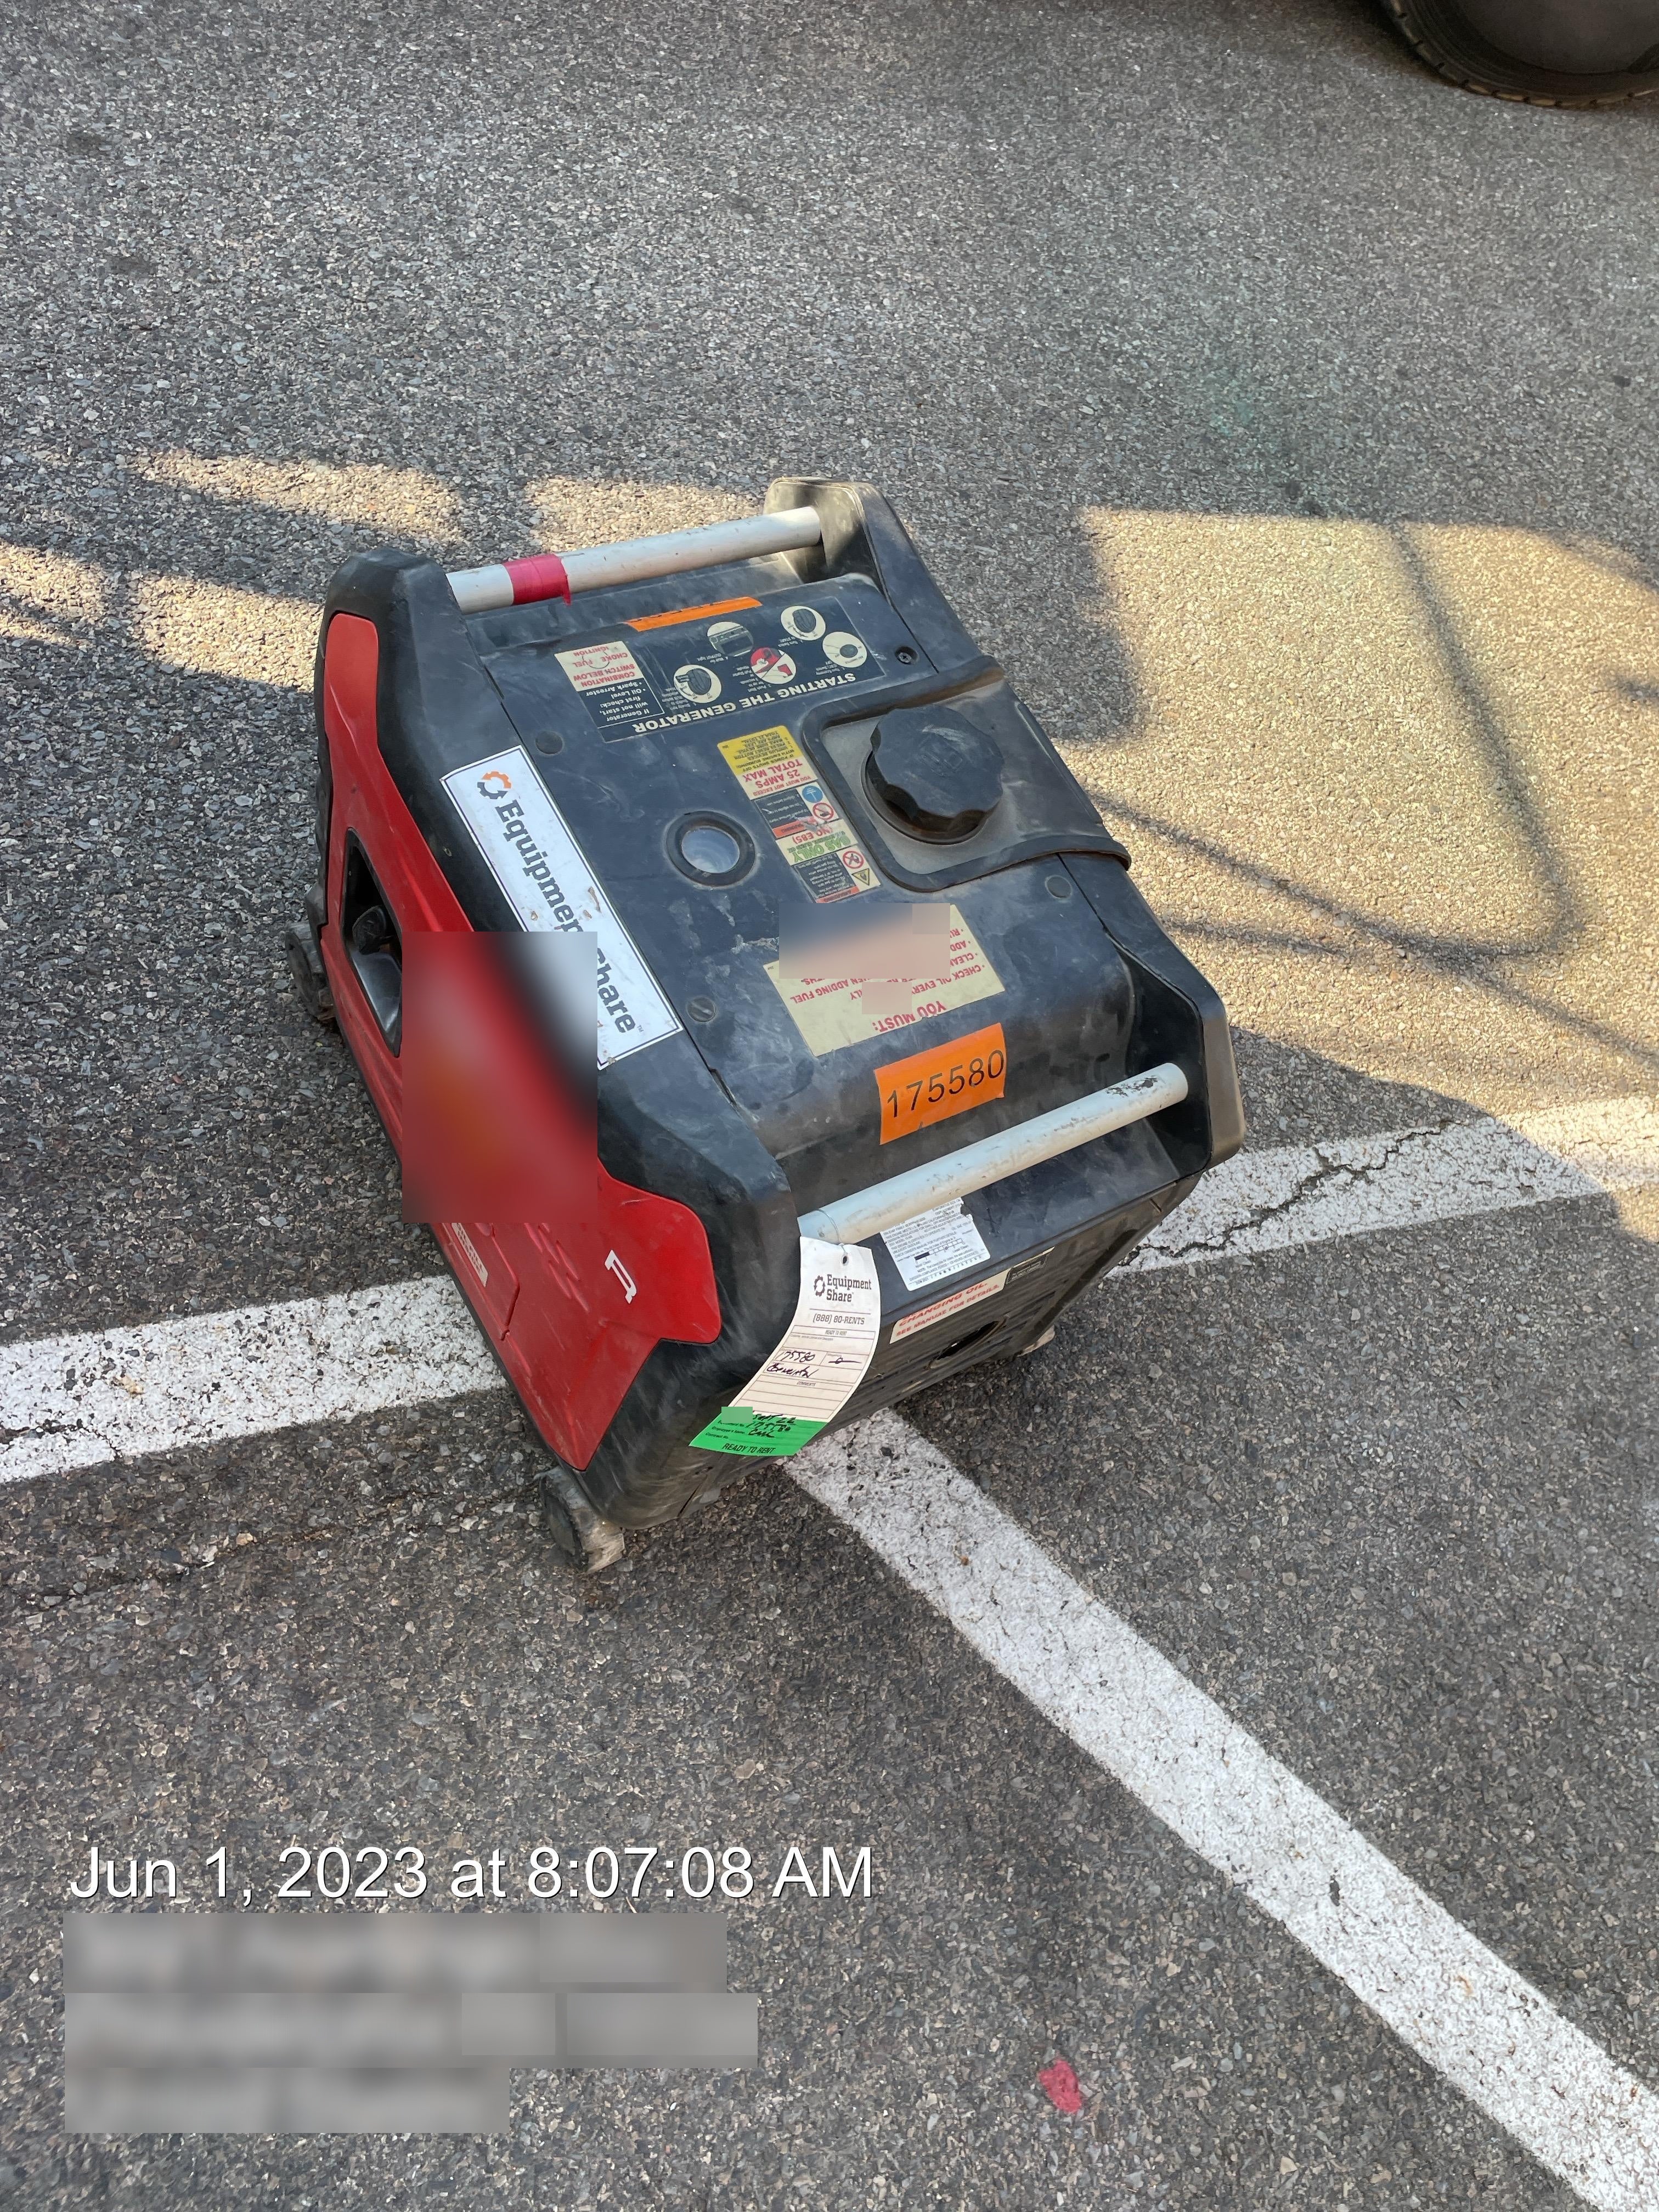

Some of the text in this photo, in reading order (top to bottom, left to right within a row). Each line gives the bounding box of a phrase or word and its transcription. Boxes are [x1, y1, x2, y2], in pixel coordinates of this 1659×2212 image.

[573, 645, 609, 657] IGNITION
[572, 651, 628, 668] CHOKE FUEL
[572, 663, 635, 681] SWITCH BELOW
[580, 670, 635, 687] COMBINATION
[584, 681, 638, 697] Spark Arrestor
[610, 690, 630, 698] Level
[599, 699, 624, 708] check:
[599, 706, 620, 715] start,
[631, 672, 857, 733] STARTING THE GENERATOR
[605, 709, 642, 722] Generator
[741, 758, 803, 782] TOTAL MAX
[753, 769, 800, 788] 25 AMPS
[752, 787, 774, 796] EXCEED
[791, 831, 815, 844] E85)
[823, 836, 852, 851] GAS
[788, 843, 826, 862] ONLY
[951, 964, 982, 980] CHECK
[814, 978, 850, 997] ADDING
[789, 990, 815, 1005] FUEL
[871, 999, 946, 1034] YOU MUST:
[887, 1050, 1004, 1118] 175580
[827, 1274, 872, 1290] Equipment
[826, 1289, 852, 1302] Share
[896, 1284, 1000, 1336] SEE MANUAL FOR DETAILS.
[900, 1283, 988, 1327] CHANGING OIL.
[812, 1313, 865, 1325] (888) 80-RENTS
[722, 1443, 748, 1451] READY
